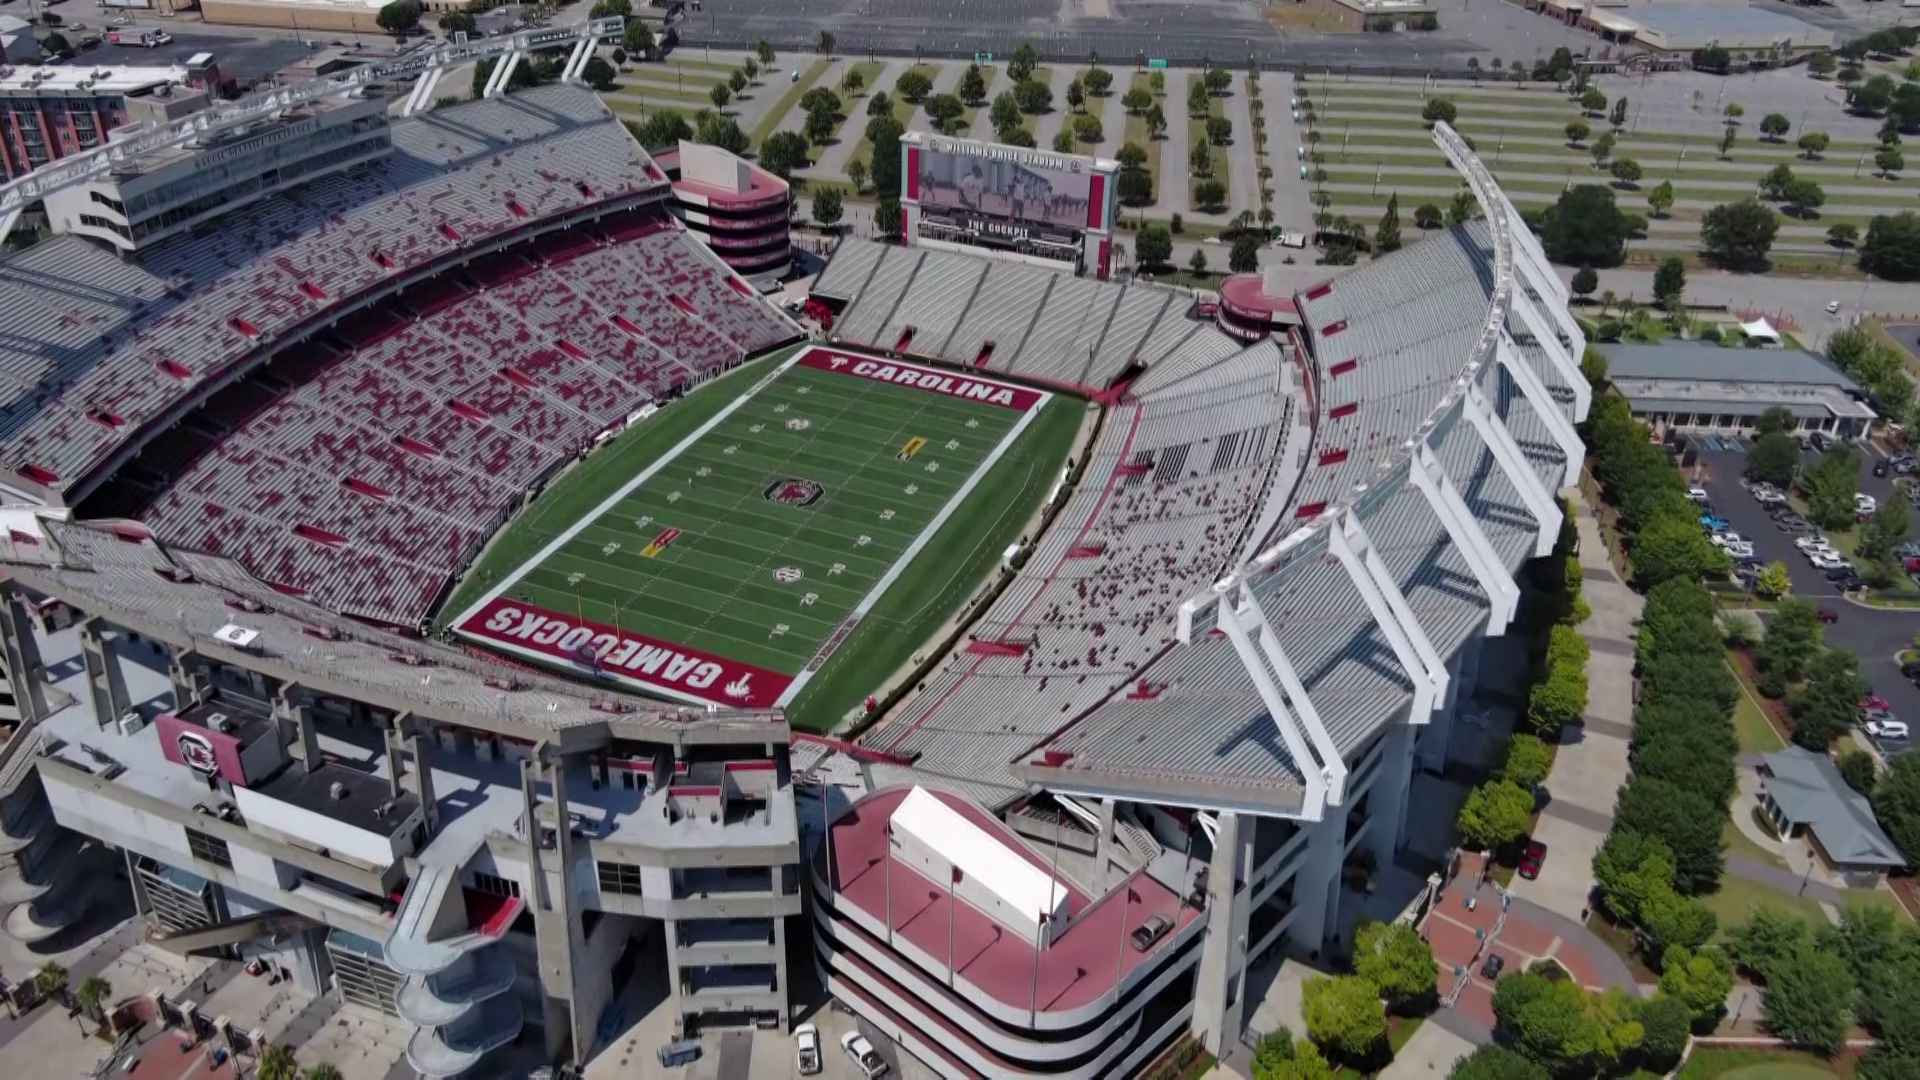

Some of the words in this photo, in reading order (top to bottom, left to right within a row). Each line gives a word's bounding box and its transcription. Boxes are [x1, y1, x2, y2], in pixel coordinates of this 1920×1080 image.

[1022, 153, 1064, 170] STADIUM
[967, 219, 985, 231] THE
[988, 222, 1029, 239] COCKPIT
[852, 360, 1015, 406] CAROLINA
[484, 606, 724, 690] GAMECOCKS
